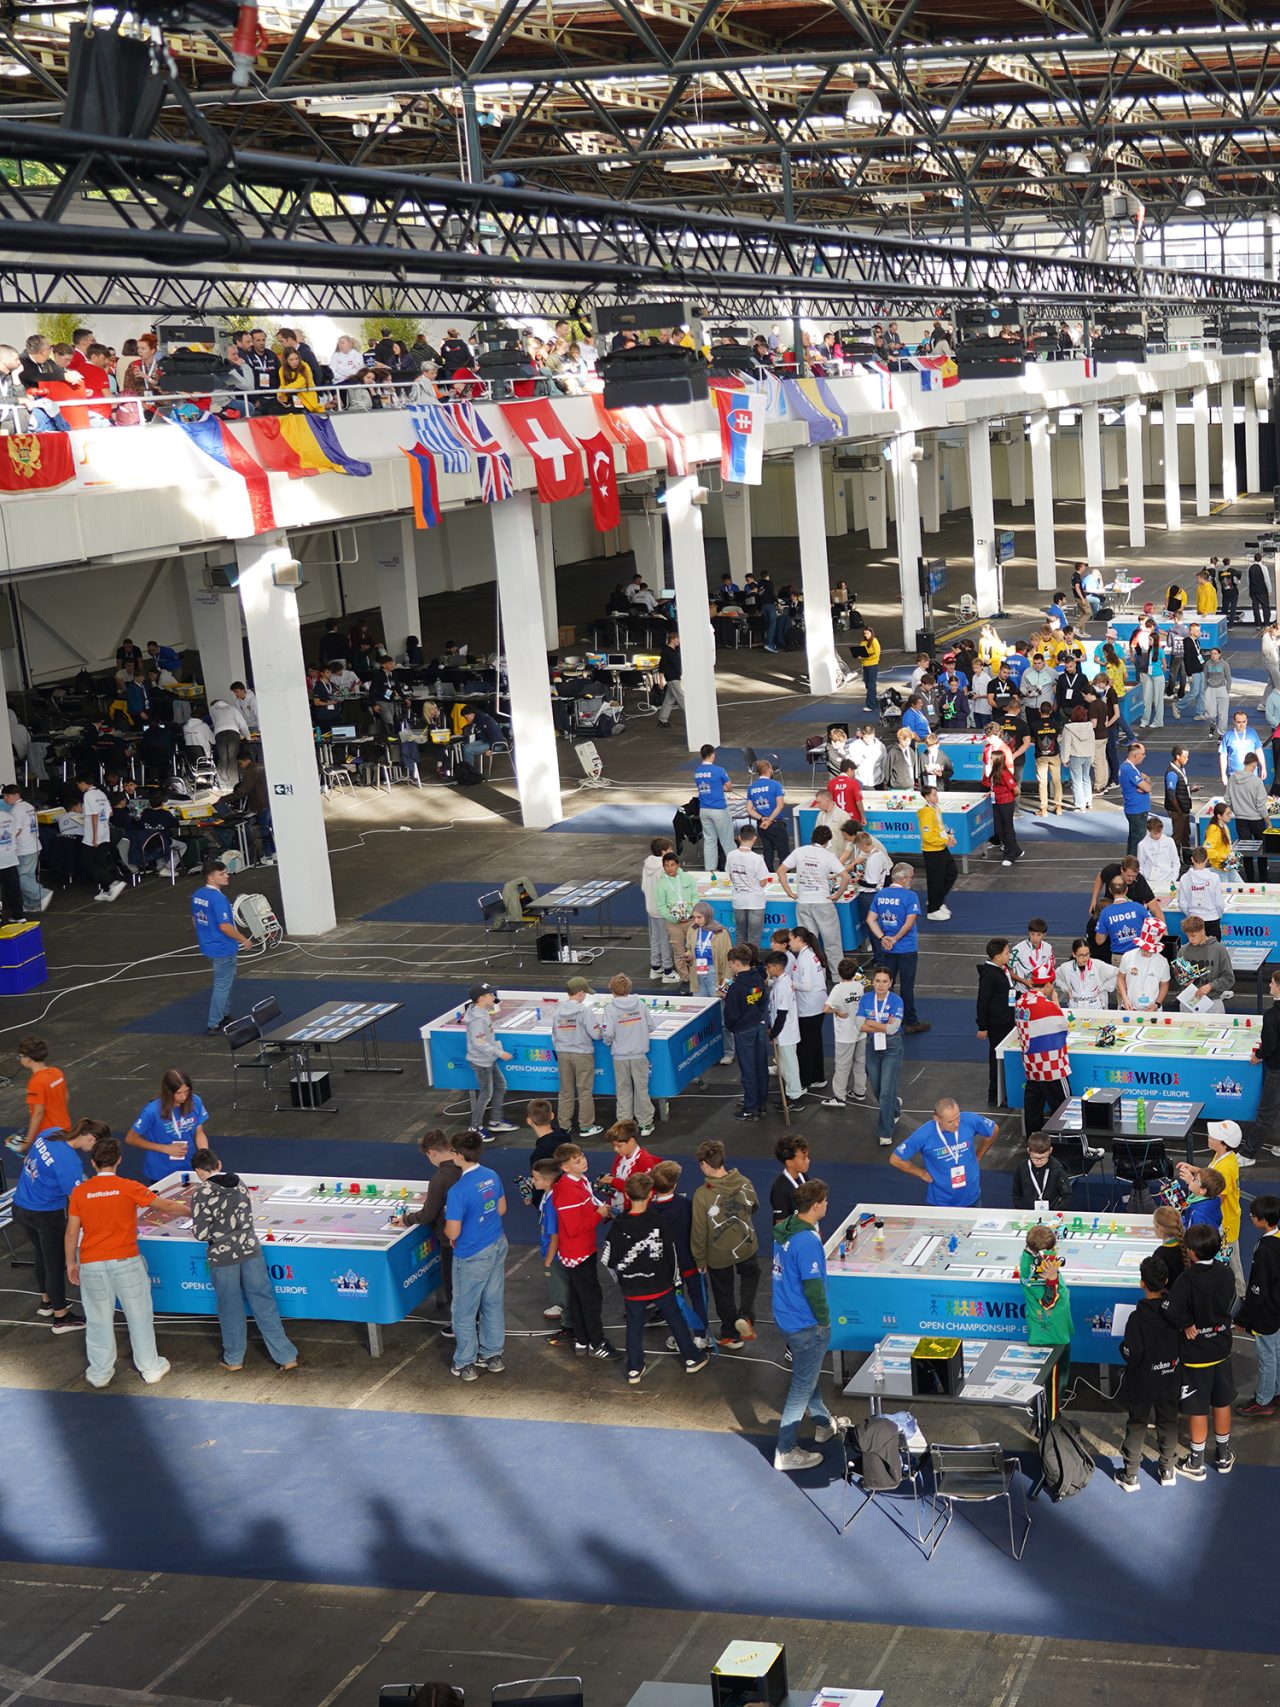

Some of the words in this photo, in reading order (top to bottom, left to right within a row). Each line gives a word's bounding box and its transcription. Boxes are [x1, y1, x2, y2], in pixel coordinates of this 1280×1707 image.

[751, 786, 769, 795] JUDGE
[836, 791, 847, 810] 4
[885, 821, 910, 831] WRO
[193, 897, 209, 907] UDGE
[878, 897, 900, 905] JUDGE
[1108, 911, 1137, 925] JUDGE
[1233, 925, 1264, 937] WRO
[505, 1064, 526, 1072] OPEN
[1134, 1071, 1173, 1086] WRO
[1162, 1089, 1191, 1098] EUROPE
[34, 1136, 55, 1167] JUDGE
[403, 1272, 418, 1288] OPEN
[181, 1282, 205, 1290] OPEN
[275, 1286, 308, 1295] EUROPE
[919, 1321, 945, 1330] OPEN
[946, 1322, 1016, 1334] CHAMPIONSHIP
